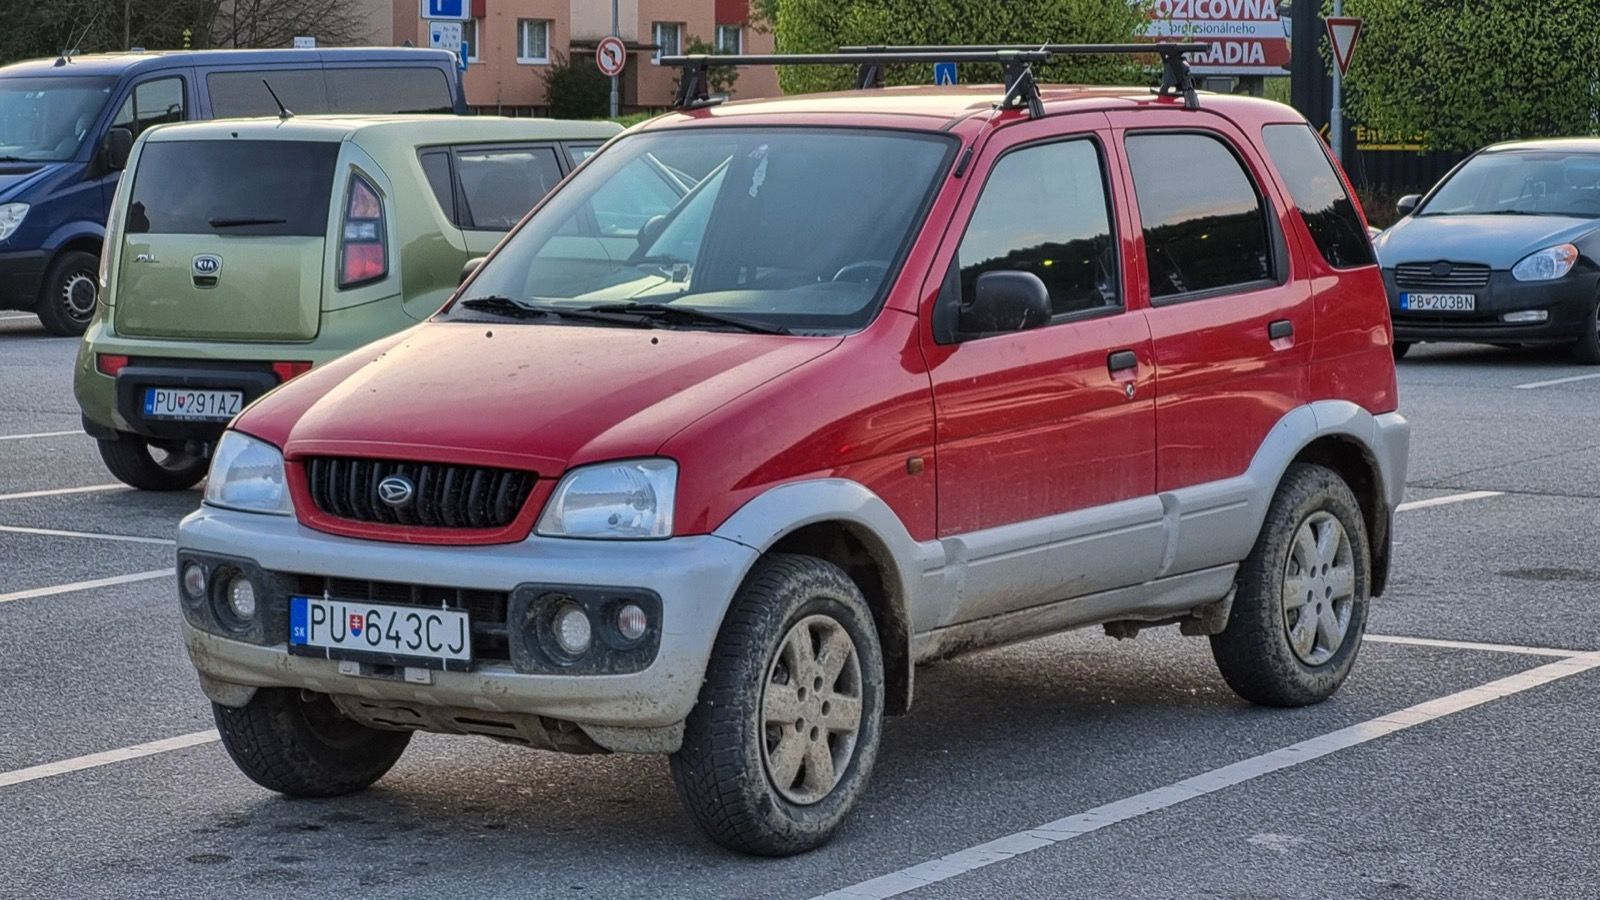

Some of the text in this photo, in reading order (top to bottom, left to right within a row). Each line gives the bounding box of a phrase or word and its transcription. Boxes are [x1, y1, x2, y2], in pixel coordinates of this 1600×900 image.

[197, 260, 215, 269] KIA
[1409, 295, 1473, 309] PB 203BN
[155, 391, 240, 415] PU 291AZ
[294, 626, 305, 637] SK
[310, 603, 464, 655] PU 643CJ
